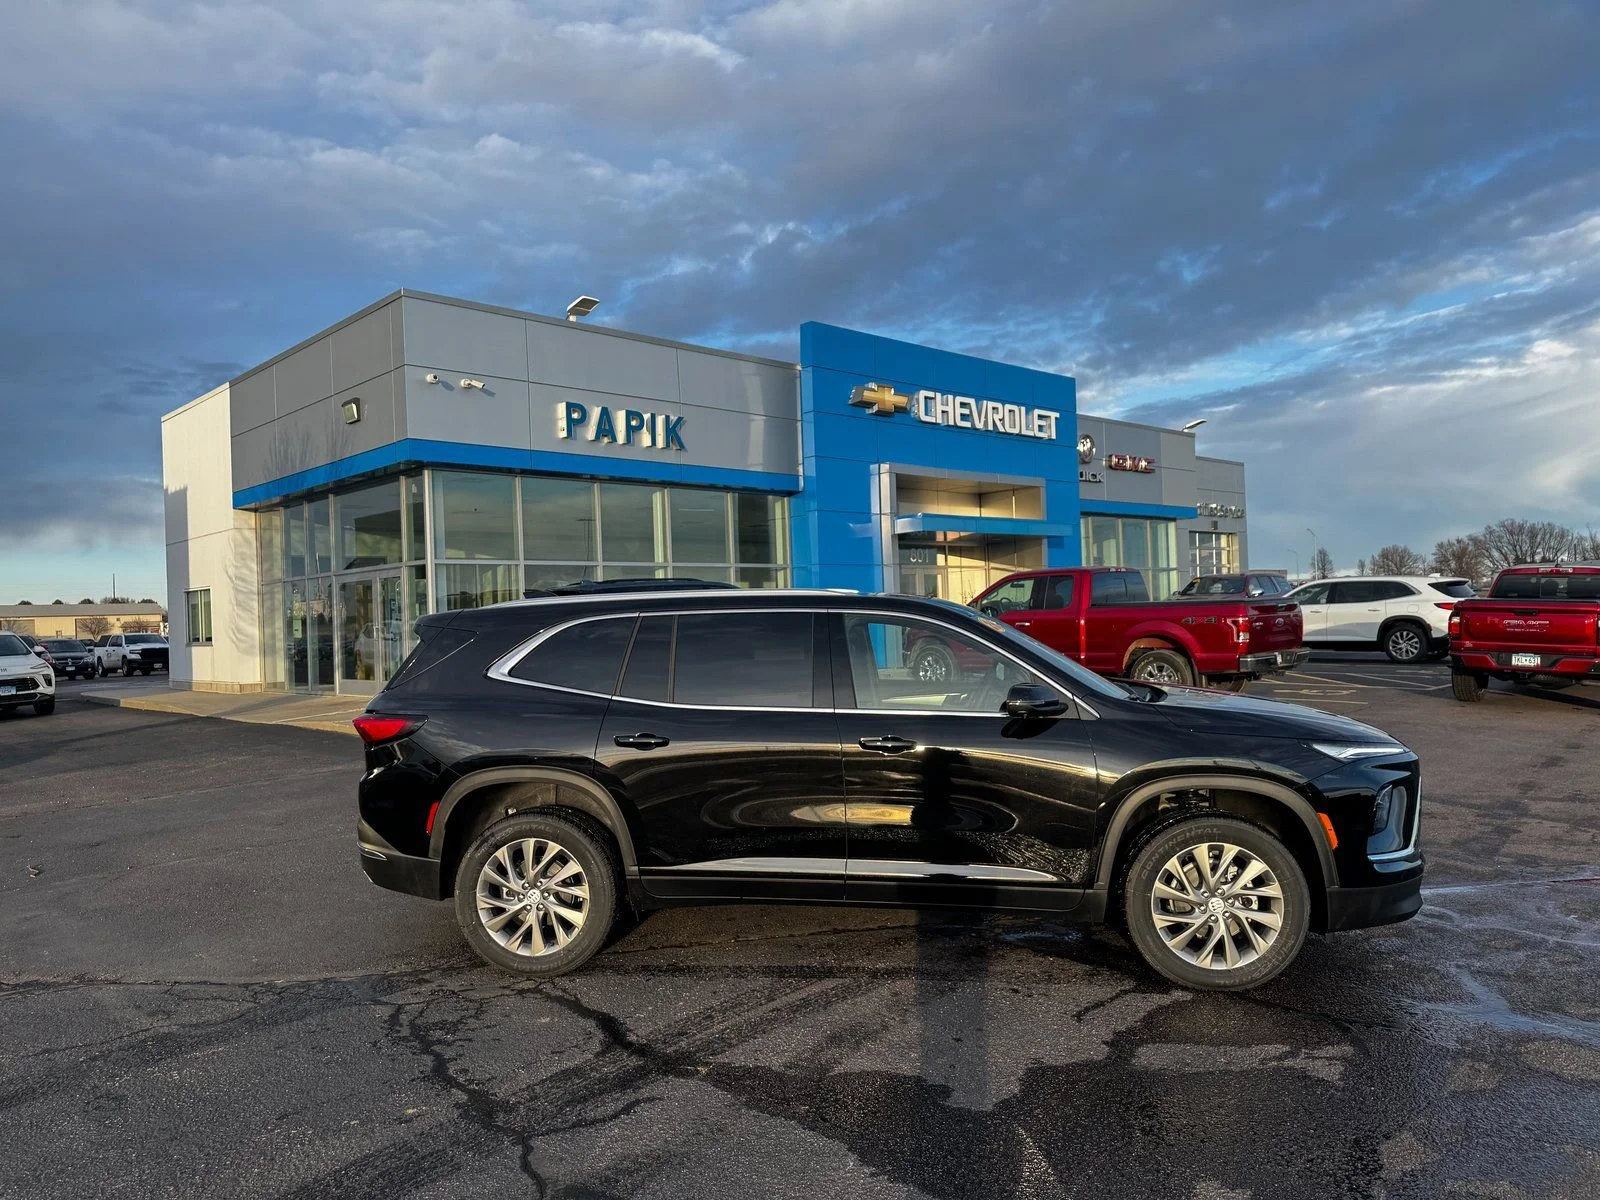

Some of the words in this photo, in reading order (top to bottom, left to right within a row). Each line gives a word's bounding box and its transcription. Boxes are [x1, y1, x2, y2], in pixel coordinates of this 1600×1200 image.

[558, 401, 686, 451] PAPIK
[914, 389, 1060, 440] CHEVROLET
[1079, 471, 1104, 483] UICK
